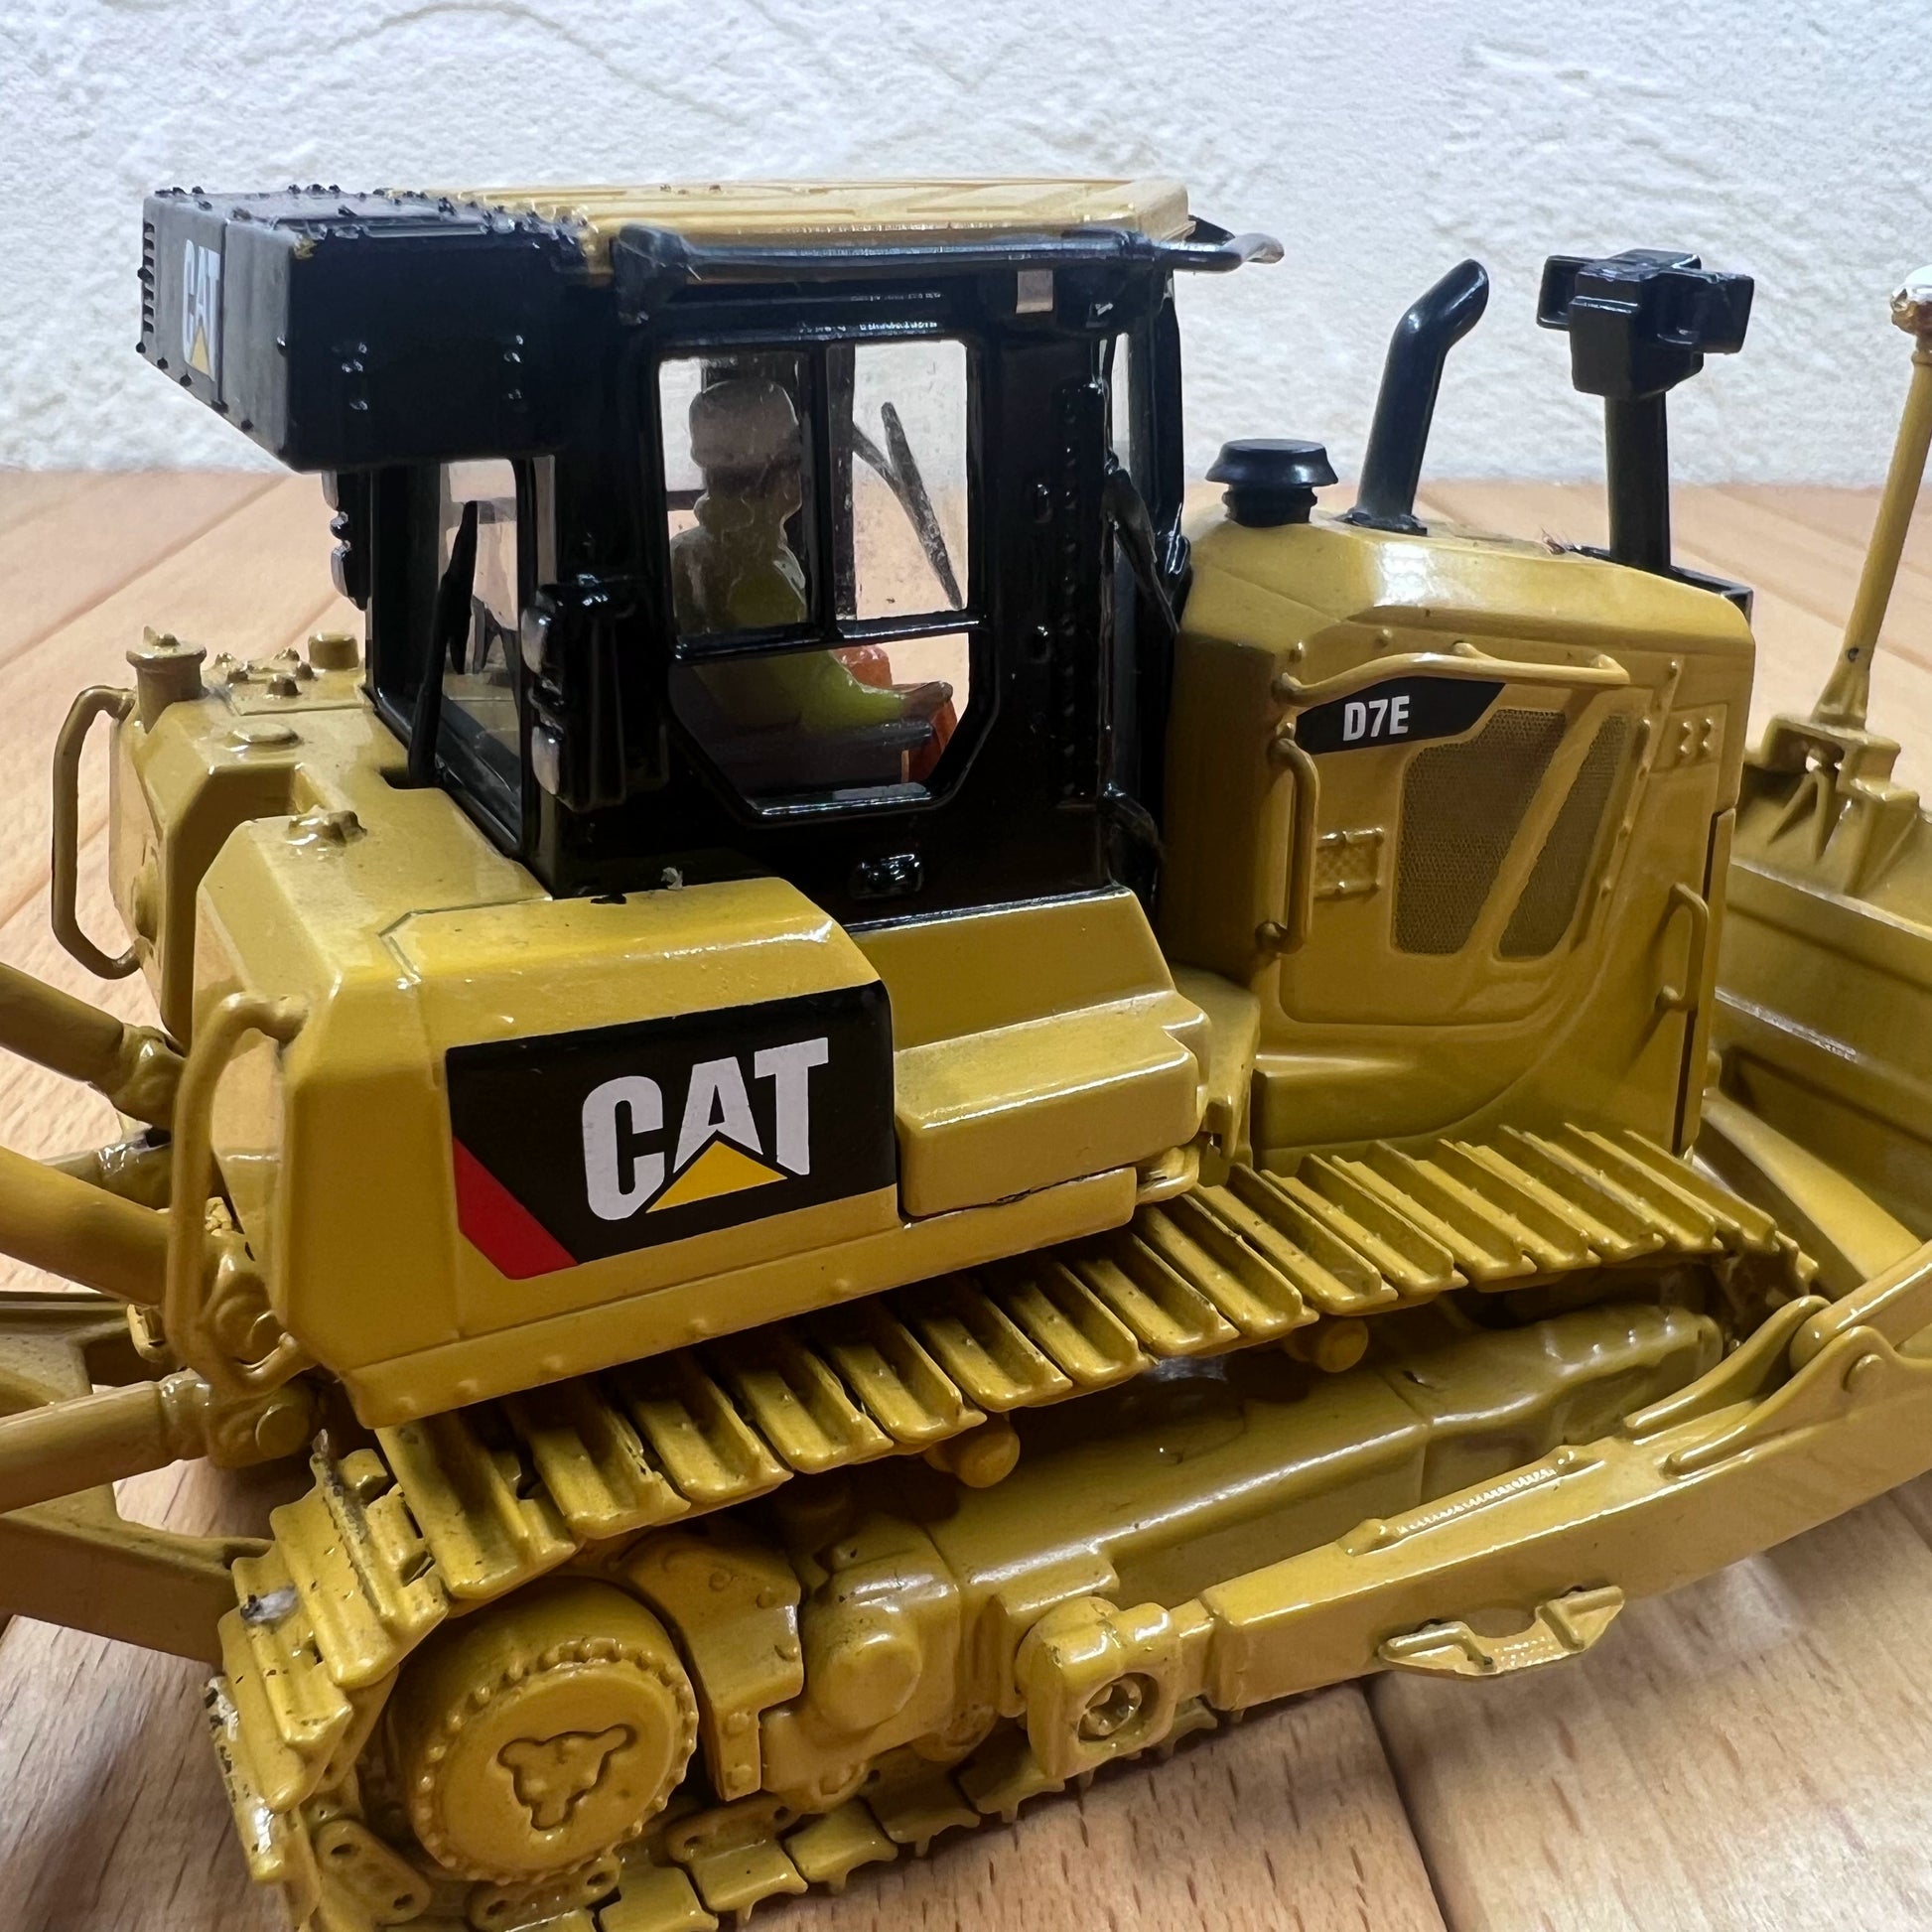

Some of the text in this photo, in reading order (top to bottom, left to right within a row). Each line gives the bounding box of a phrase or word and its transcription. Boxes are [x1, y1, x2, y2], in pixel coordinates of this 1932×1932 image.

[183, 238, 220, 381] CAT
[1343, 696, 1410, 742] D7E
[582, 1036, 829, 1221] CAT
